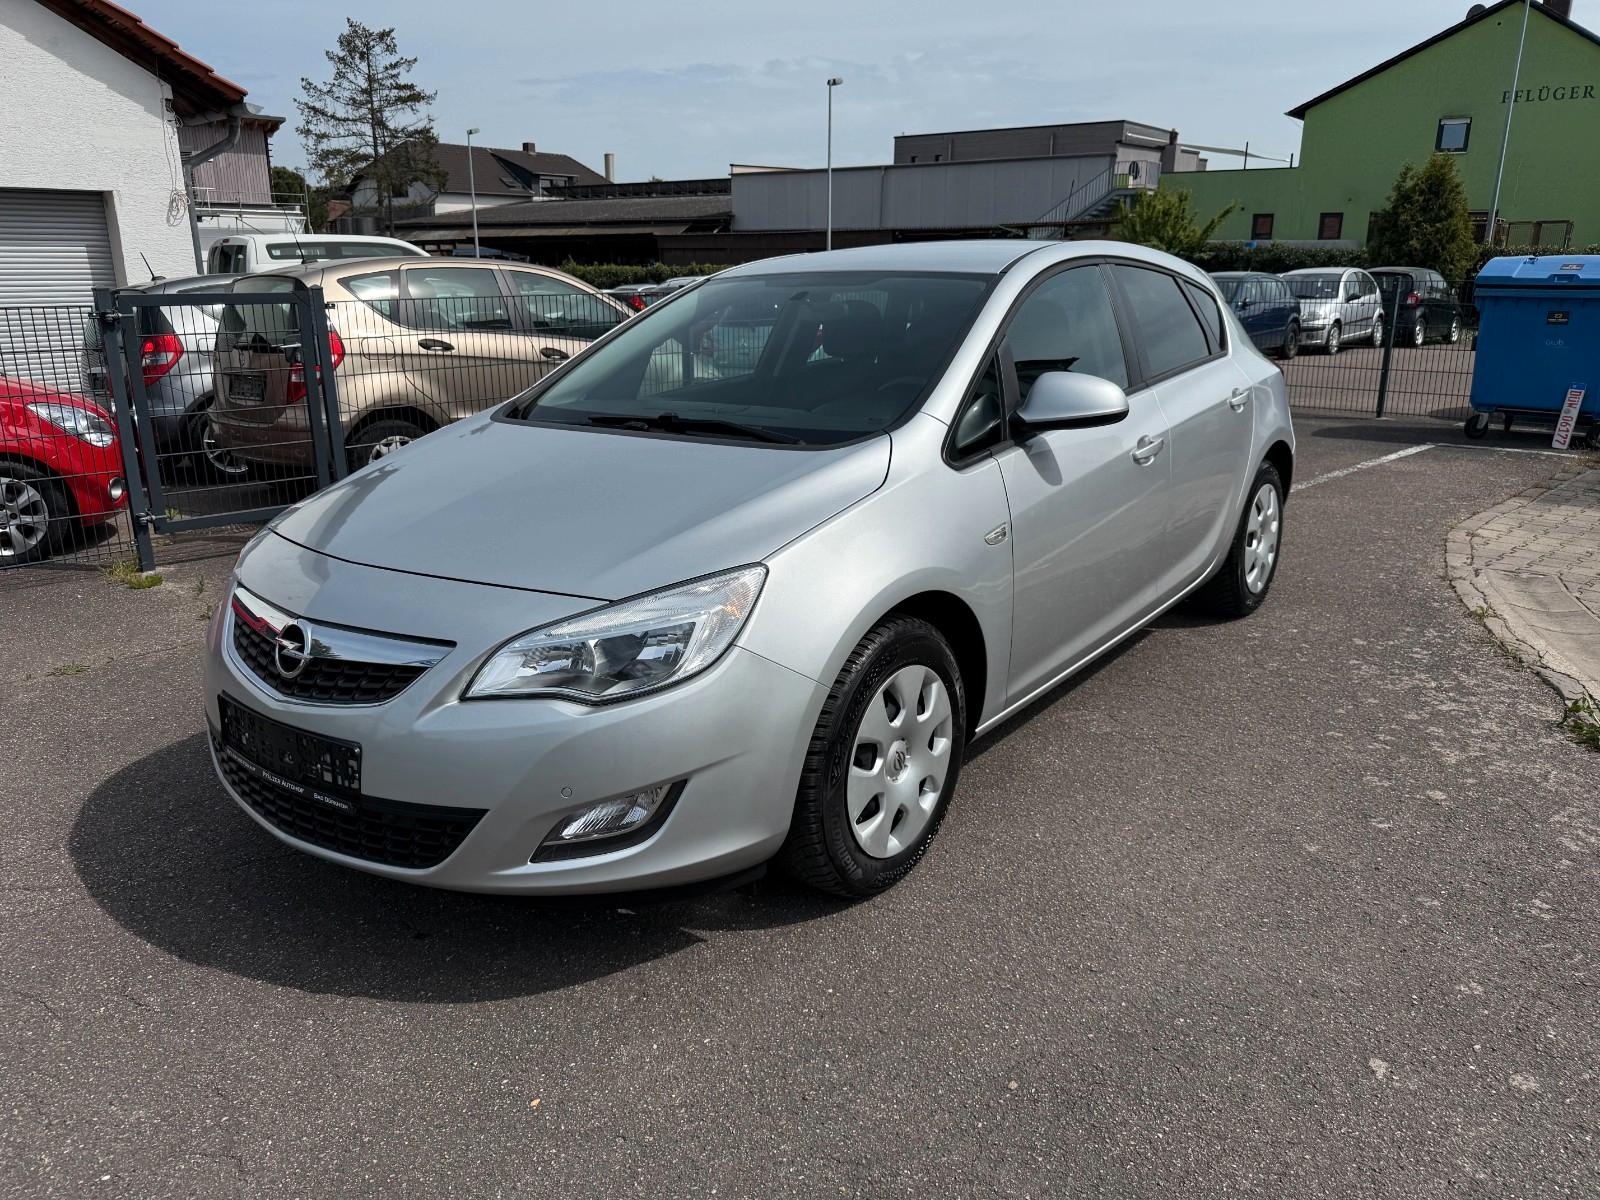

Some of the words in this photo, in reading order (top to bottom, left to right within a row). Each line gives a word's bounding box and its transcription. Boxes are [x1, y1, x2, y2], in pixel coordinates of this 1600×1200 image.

[1501, 85, 1596, 103] PFLÜGER
[1567, 390, 1582, 409] DÜW
[1555, 415, 1574, 446] 06177
